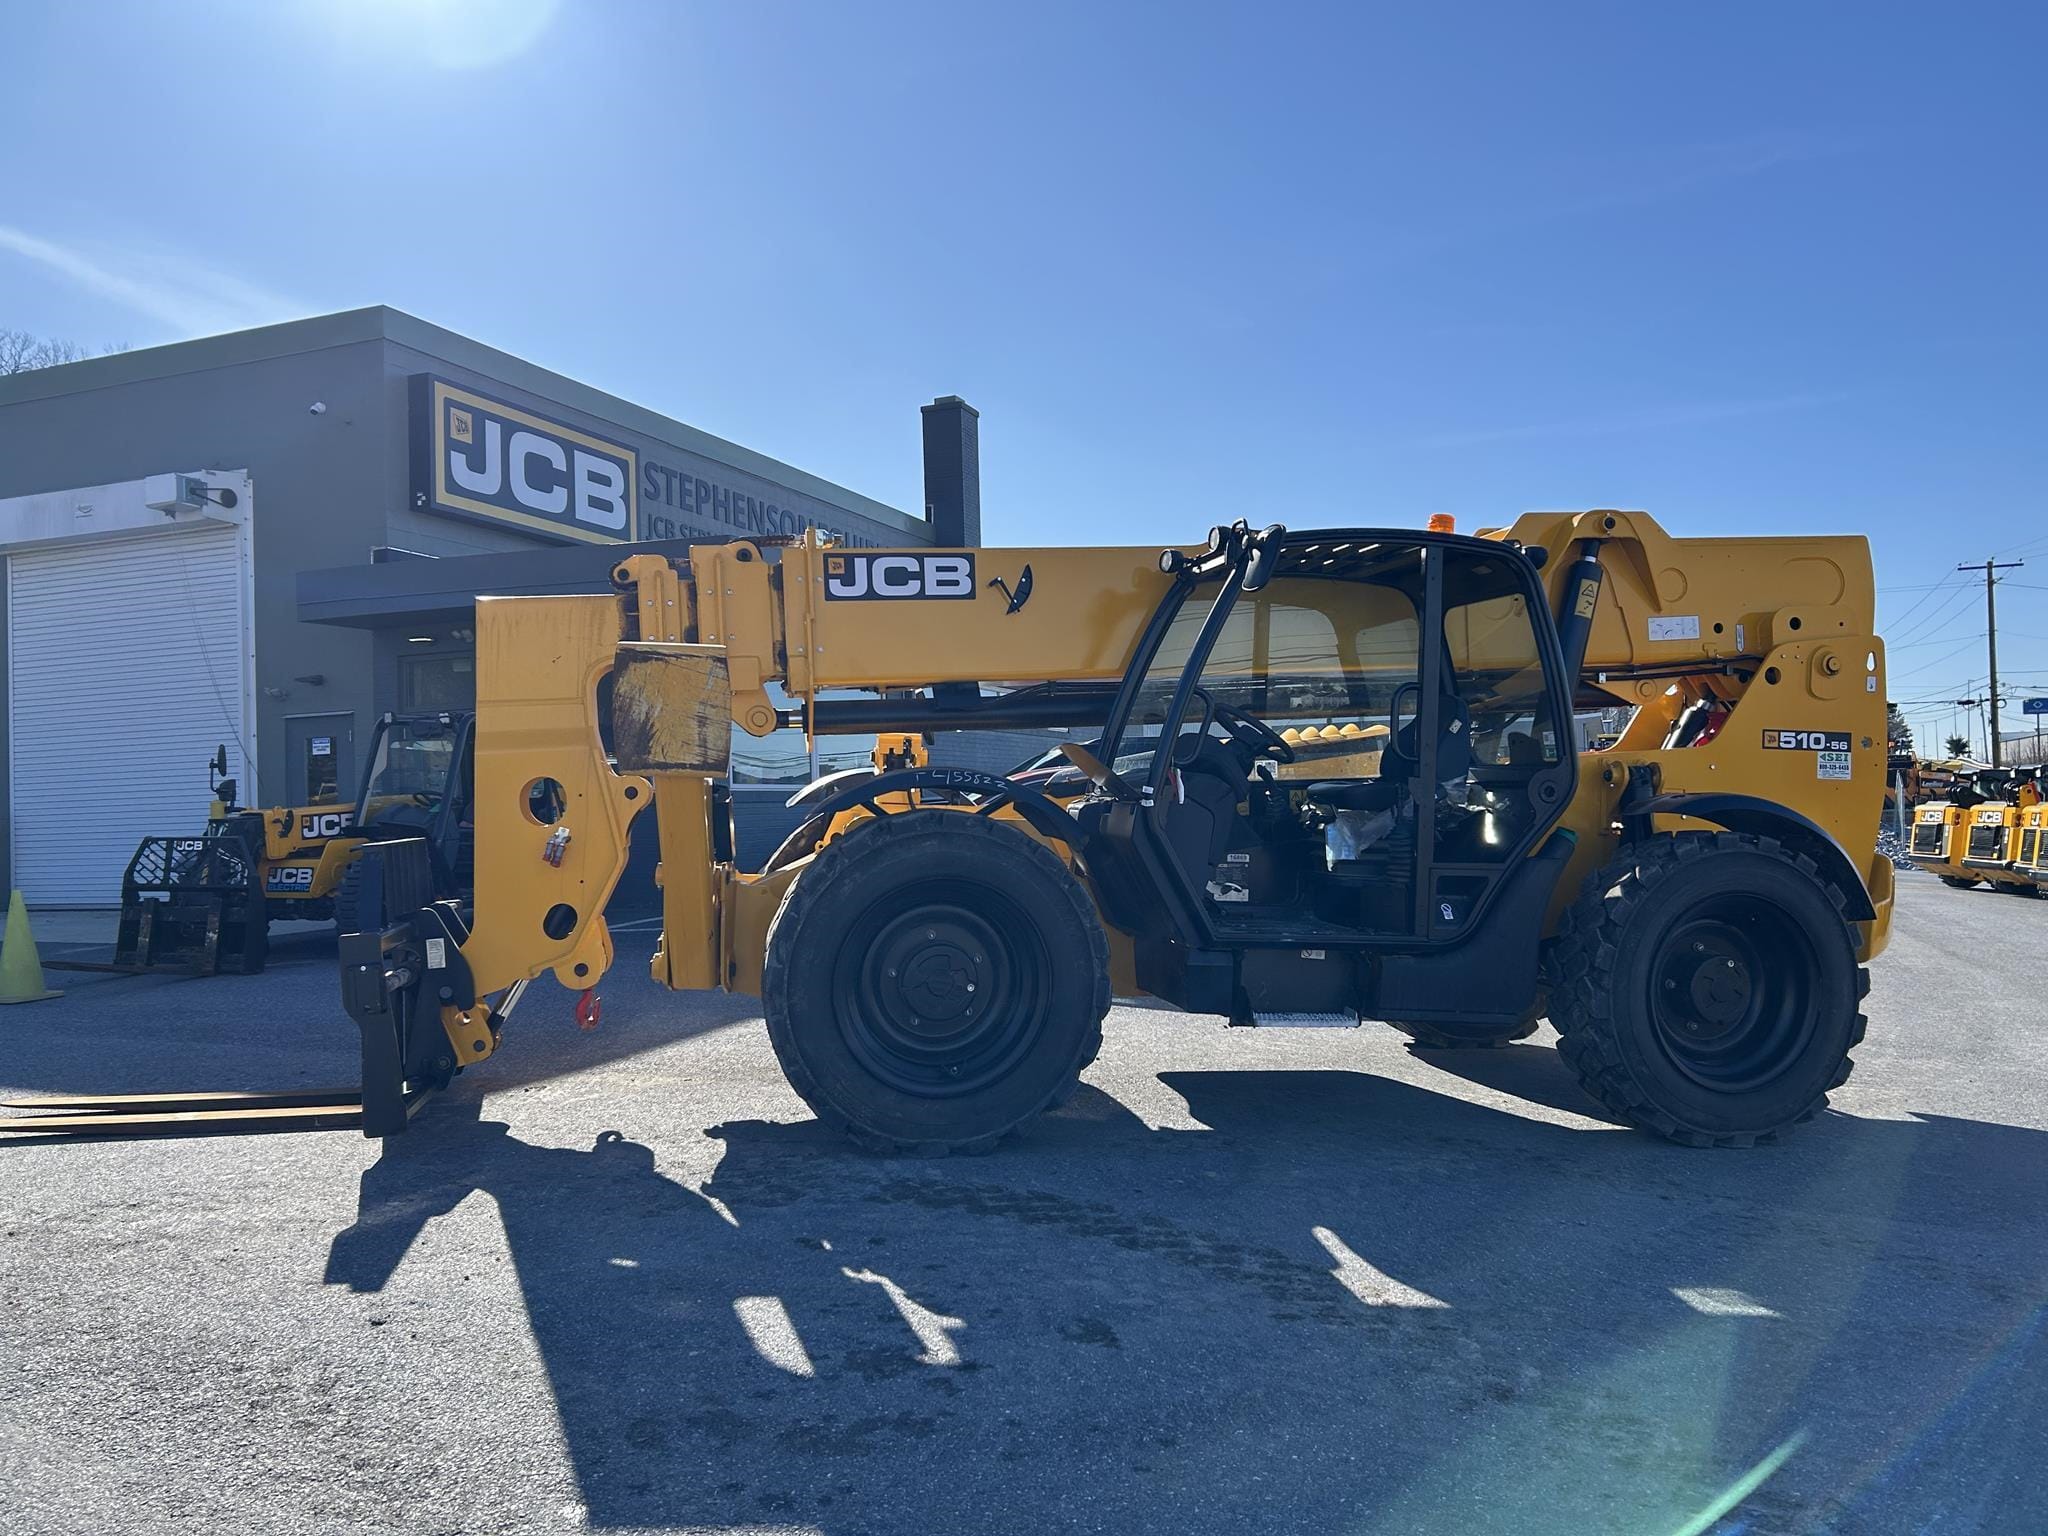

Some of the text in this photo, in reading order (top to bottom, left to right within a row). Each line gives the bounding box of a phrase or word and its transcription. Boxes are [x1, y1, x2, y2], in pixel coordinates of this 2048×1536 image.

[449, 419, 628, 531] JCB
[646, 513, 675, 539] JCB
[828, 556, 972, 598] JCB
[1779, 731, 1848, 750] 510-56
[1826, 752, 1849, 762] SEI
[1921, 811, 1942, 822] JCB
[1977, 811, 2002, 823] JCB
[176, 840, 203, 851] JCB
[268, 868, 313, 884] JCB
[267, 883, 311, 891] ELECTRIC
